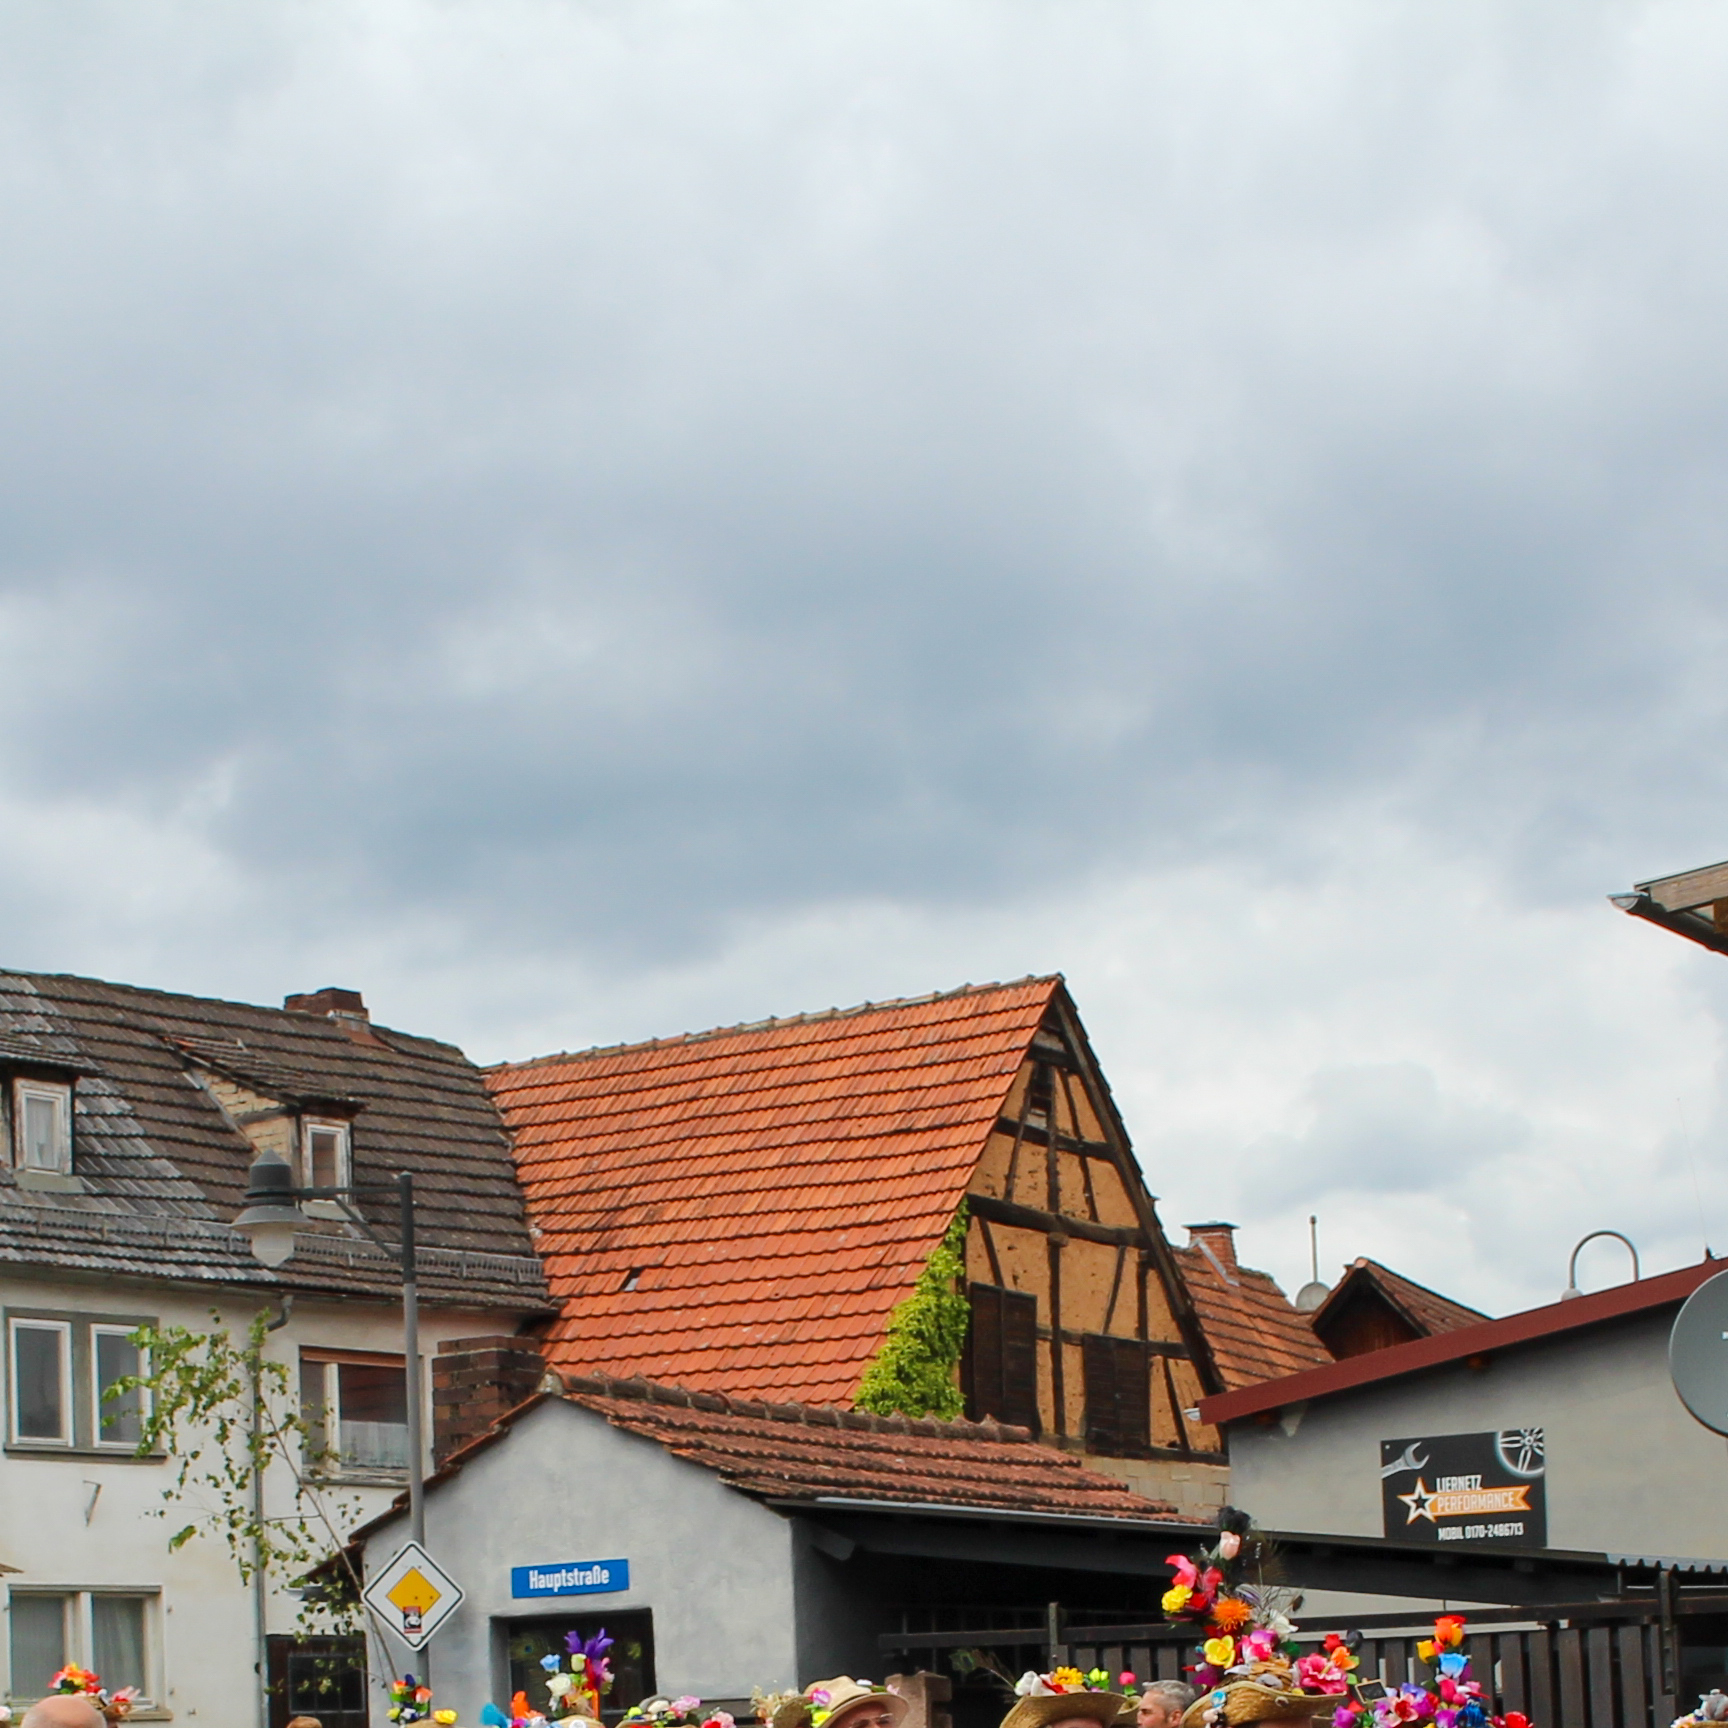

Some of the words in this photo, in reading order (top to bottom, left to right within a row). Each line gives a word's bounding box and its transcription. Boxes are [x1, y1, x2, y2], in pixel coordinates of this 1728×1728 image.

[1436, 1474, 1483, 1493] LIERNETZ
[1437, 1491, 1515, 1512] PERFORMANCE
[1438, 1526, 1464, 1541] MOBIL
[528, 1564, 610, 1592] Hauptstraße
